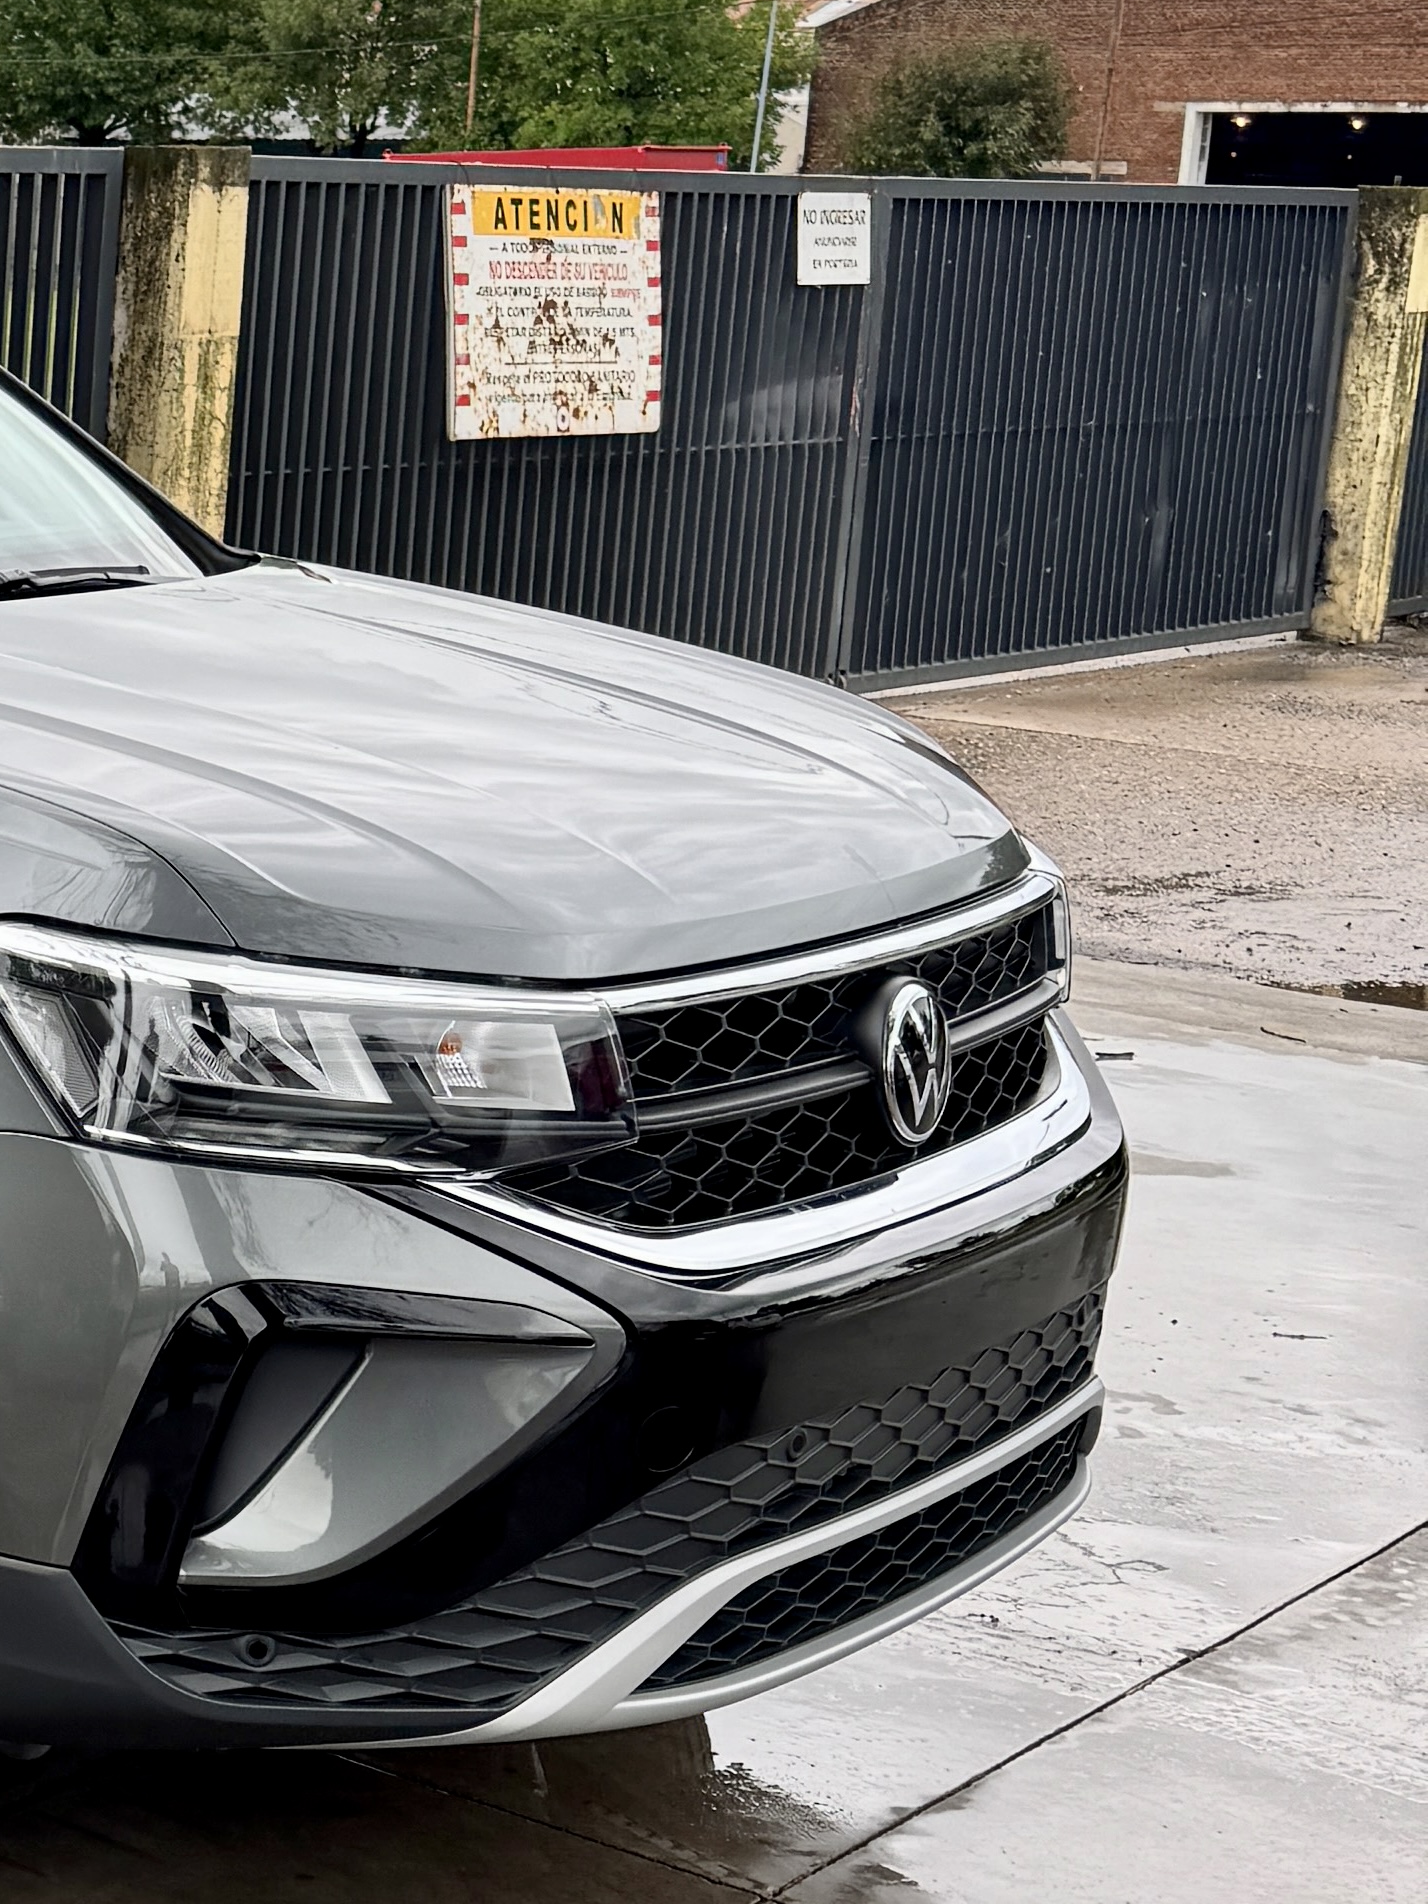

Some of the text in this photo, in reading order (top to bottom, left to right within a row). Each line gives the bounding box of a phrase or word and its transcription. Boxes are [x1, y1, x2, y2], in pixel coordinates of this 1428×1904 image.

[494, 196, 624, 234] ATENCIN
[803, 209, 866, 225] NO INGRESAR
[488, 260, 502, 280] NO
